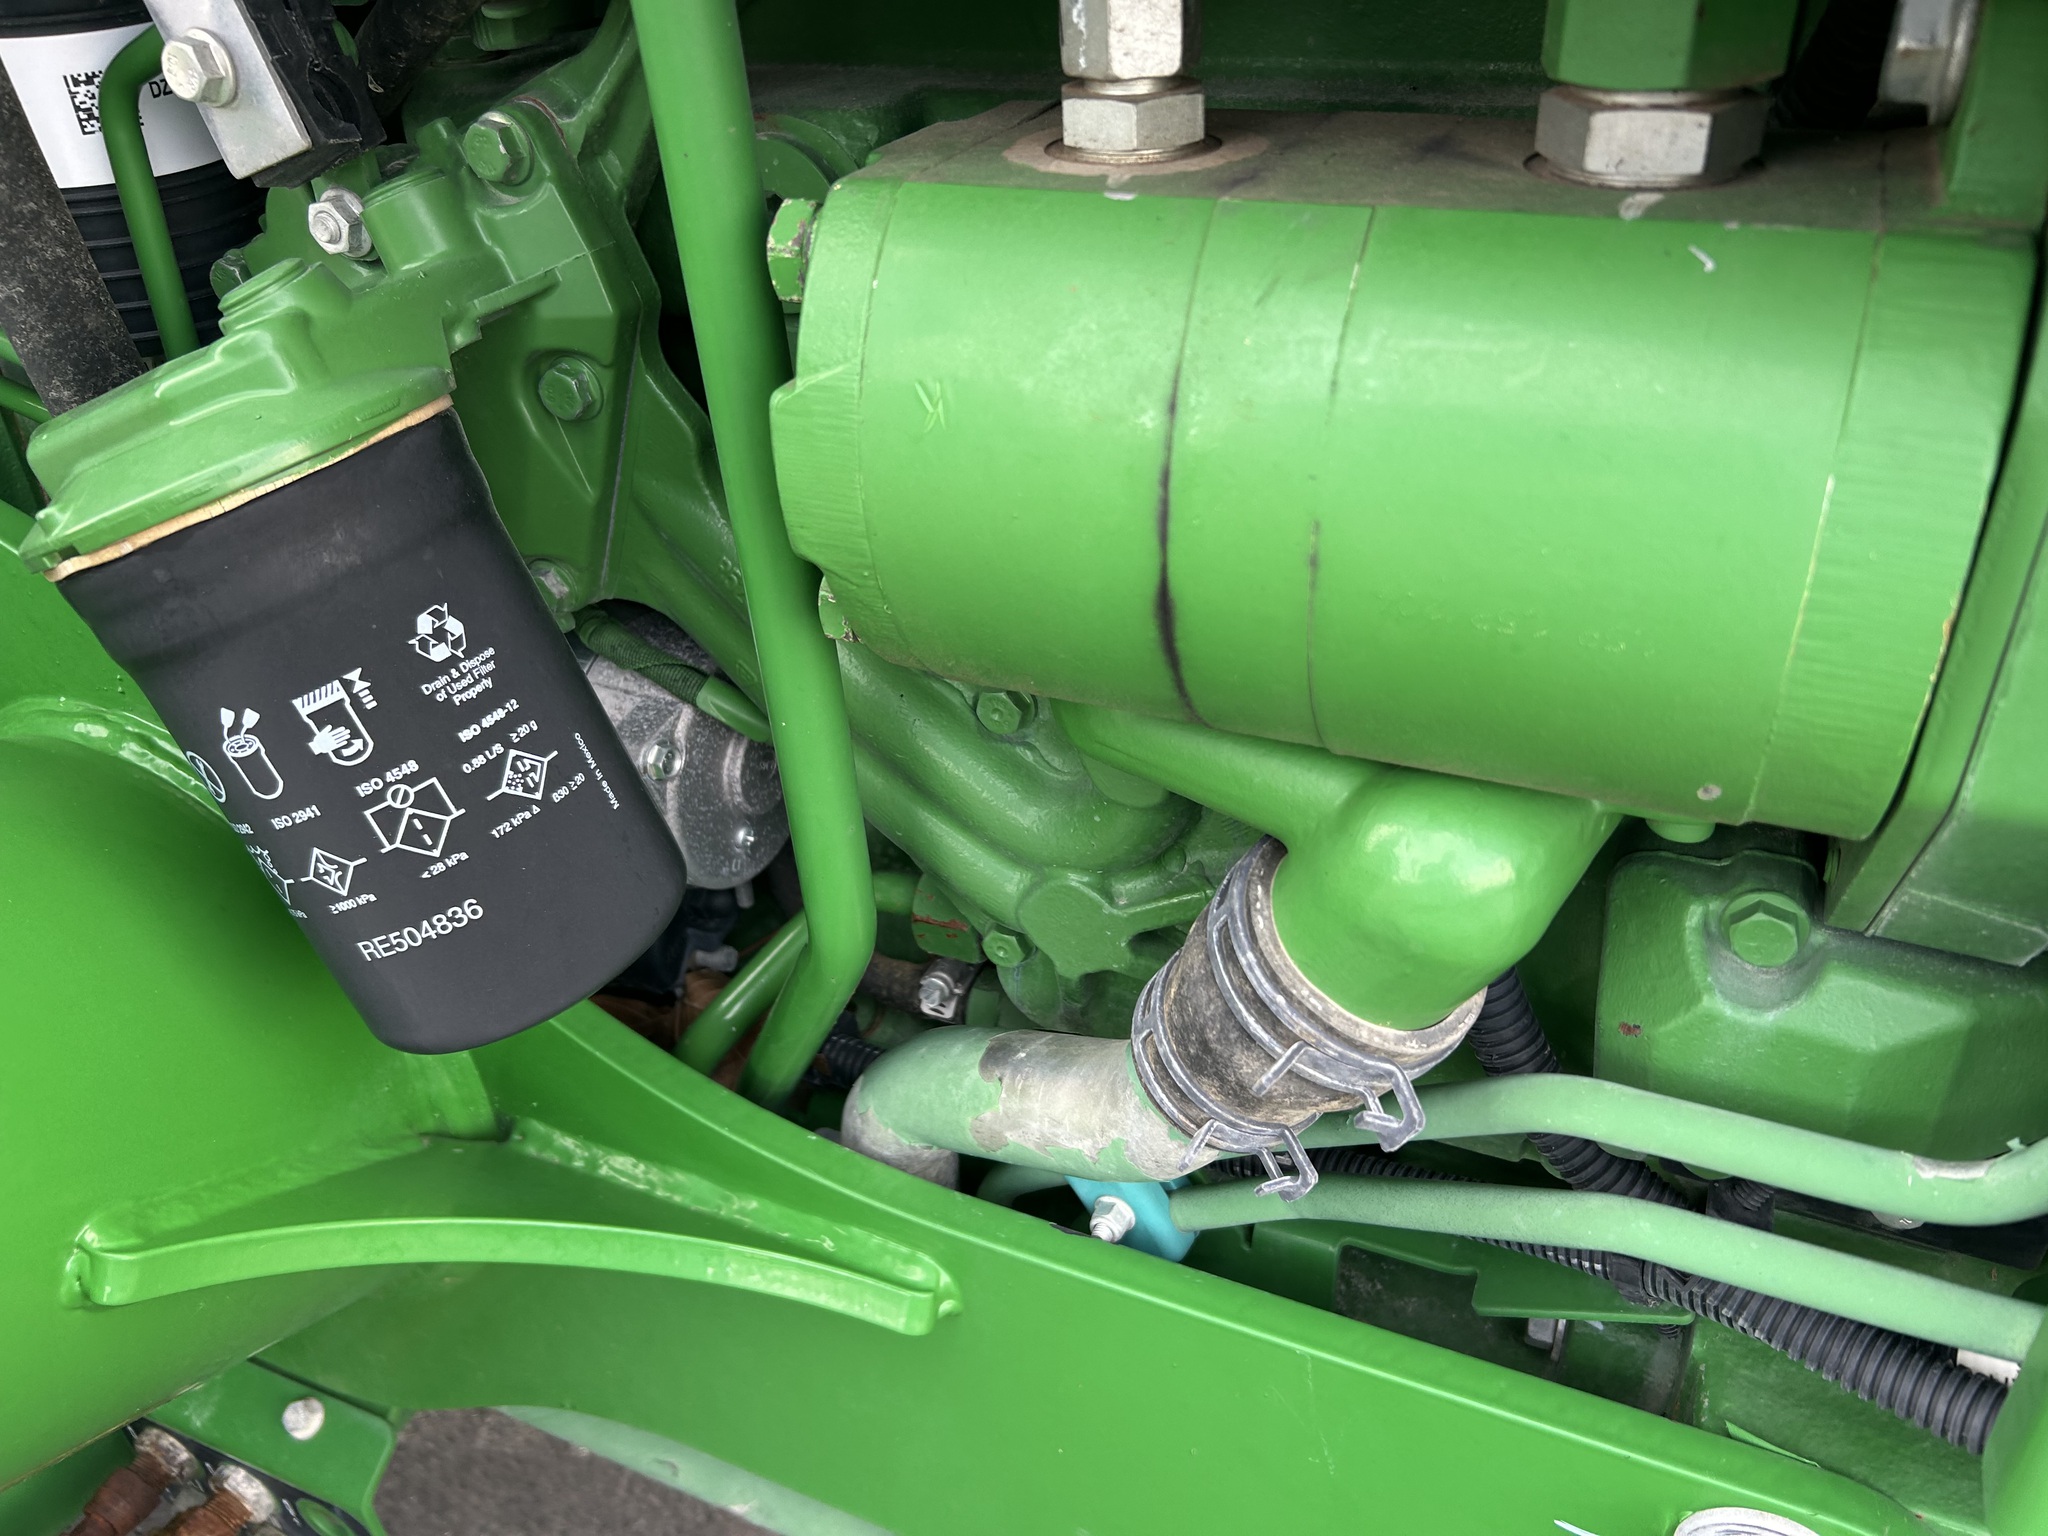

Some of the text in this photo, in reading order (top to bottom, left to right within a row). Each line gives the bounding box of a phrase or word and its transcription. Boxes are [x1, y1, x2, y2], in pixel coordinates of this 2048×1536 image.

[421, 647, 496, 695] Drain & Dispose
[436, 660, 496, 702] of Used Filter
[453, 677, 493, 706] Properly
[457, 724, 481, 742] ISO
[462, 754, 486, 774] 0.88
[574, 732, 597, 769] Mexico
[356, 760, 419, 798] ISO 4548
[602, 780, 620, 810] Made
[270, 805, 321, 830] ISO 2941
[490, 821, 513, 838] 172
[511, 810, 533, 827] kPa
[444, 852, 470, 868] kPa
[355, 893, 378, 906] kPa
[357, 898, 484, 961] RE504836
